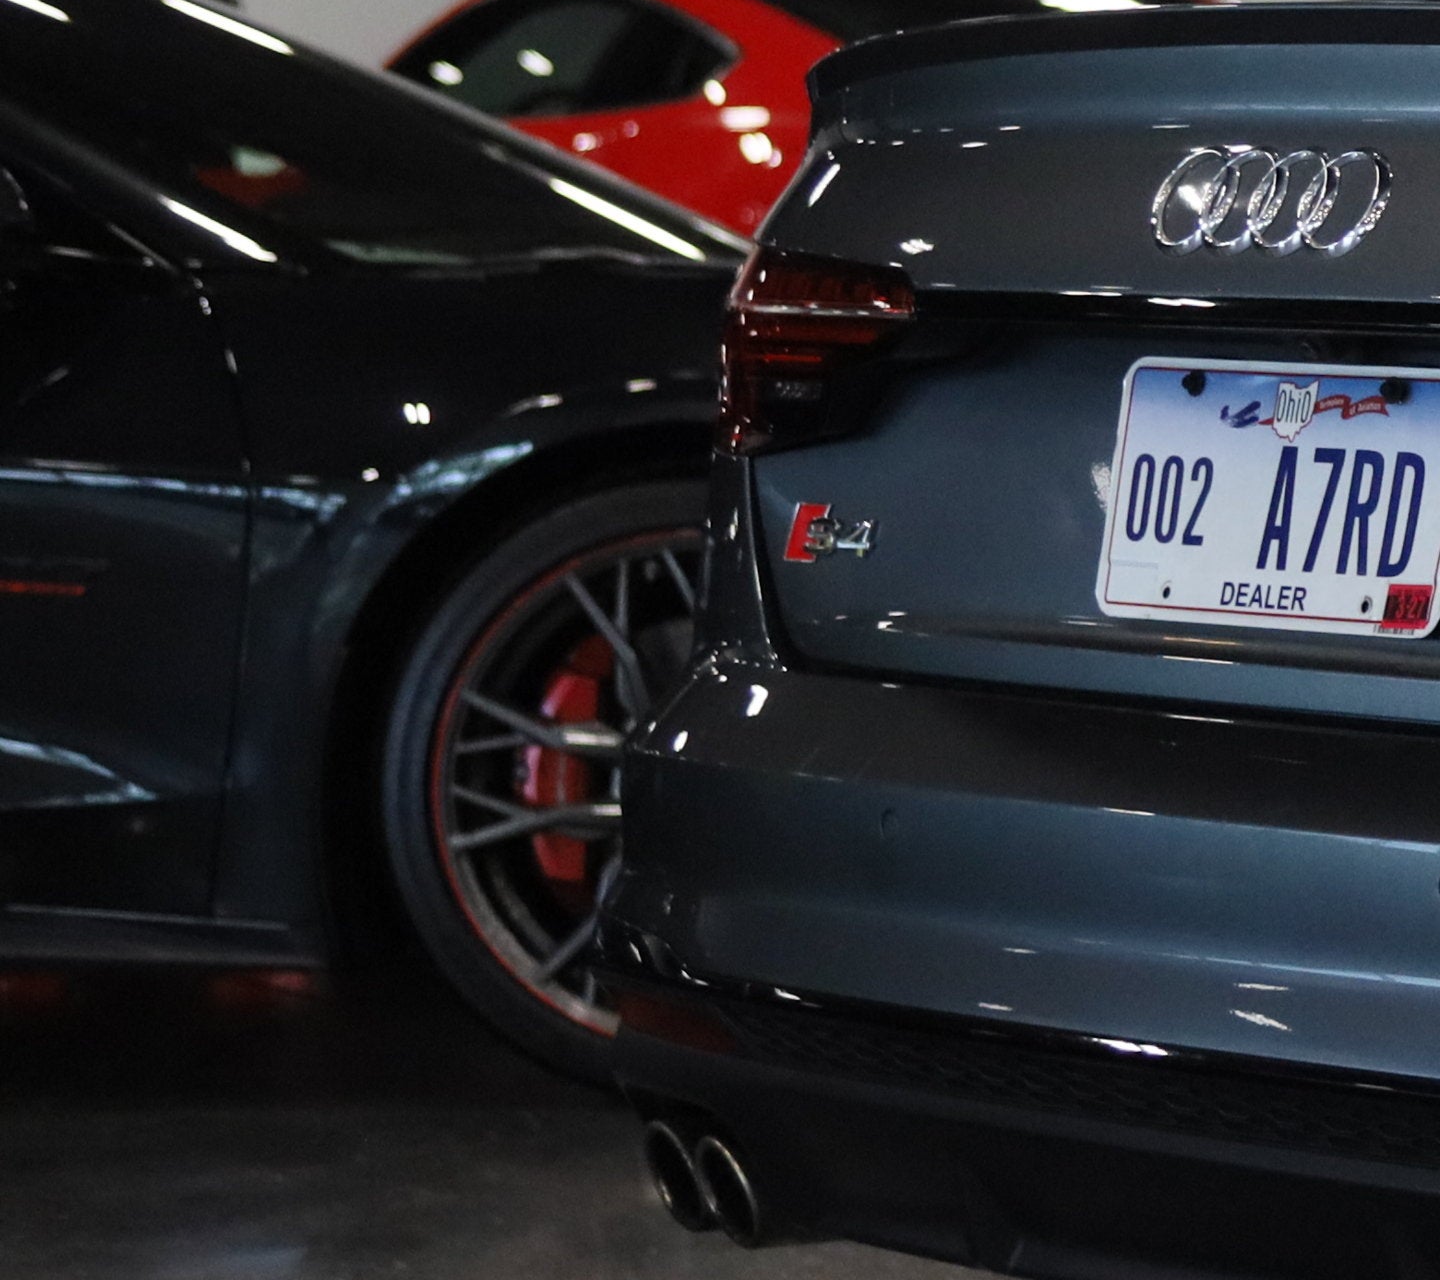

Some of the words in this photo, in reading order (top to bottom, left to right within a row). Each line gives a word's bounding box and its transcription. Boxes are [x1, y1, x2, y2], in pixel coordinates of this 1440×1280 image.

[1125, 453, 1214, 547] 002
[1256, 445, 1426, 578] A7RD
[802, 516, 874, 559] S4
[1220, 581, 1308, 612] DEALER
